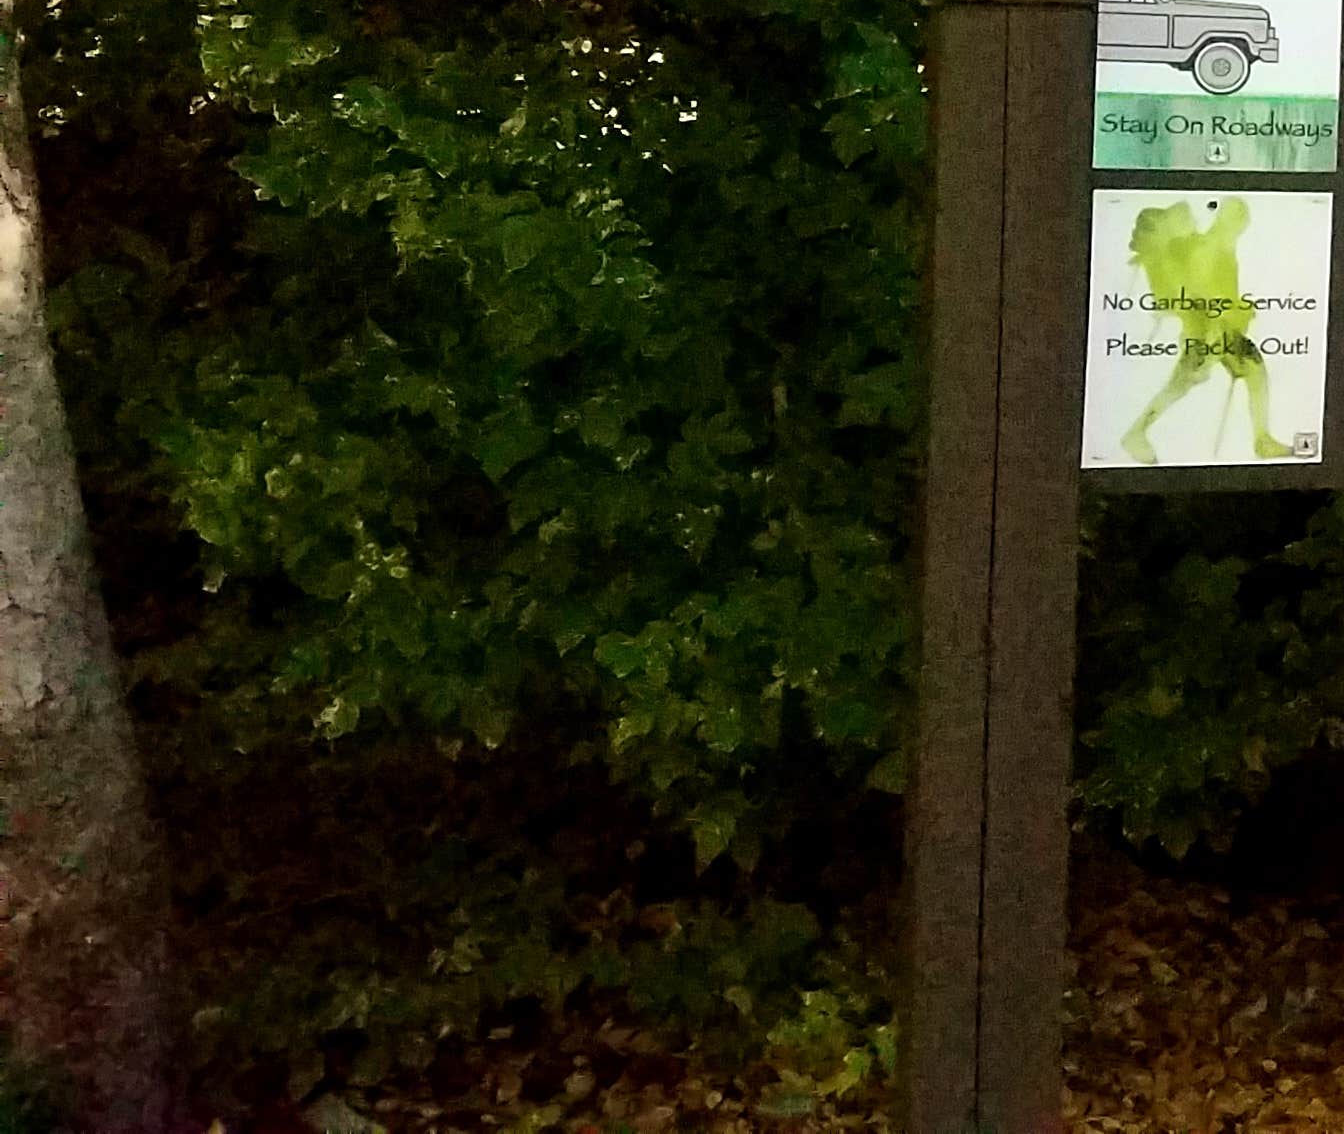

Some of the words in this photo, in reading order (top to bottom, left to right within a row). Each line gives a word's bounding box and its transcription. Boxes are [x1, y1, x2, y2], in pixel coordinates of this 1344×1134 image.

[1100, 113, 1157, 144] Stay
[1165, 116, 1204, 136] On
[1212, 111, 1332, 146] Roadways
[1103, 294, 1133, 311] No
[1140, 287, 1232, 318] Garbage
[1239, 293, 1317, 311] Service
[1106, 333, 1178, 356] Please
[1185, 332, 1235, 356] Pack
[1260, 337, 1309, 355] Out!
